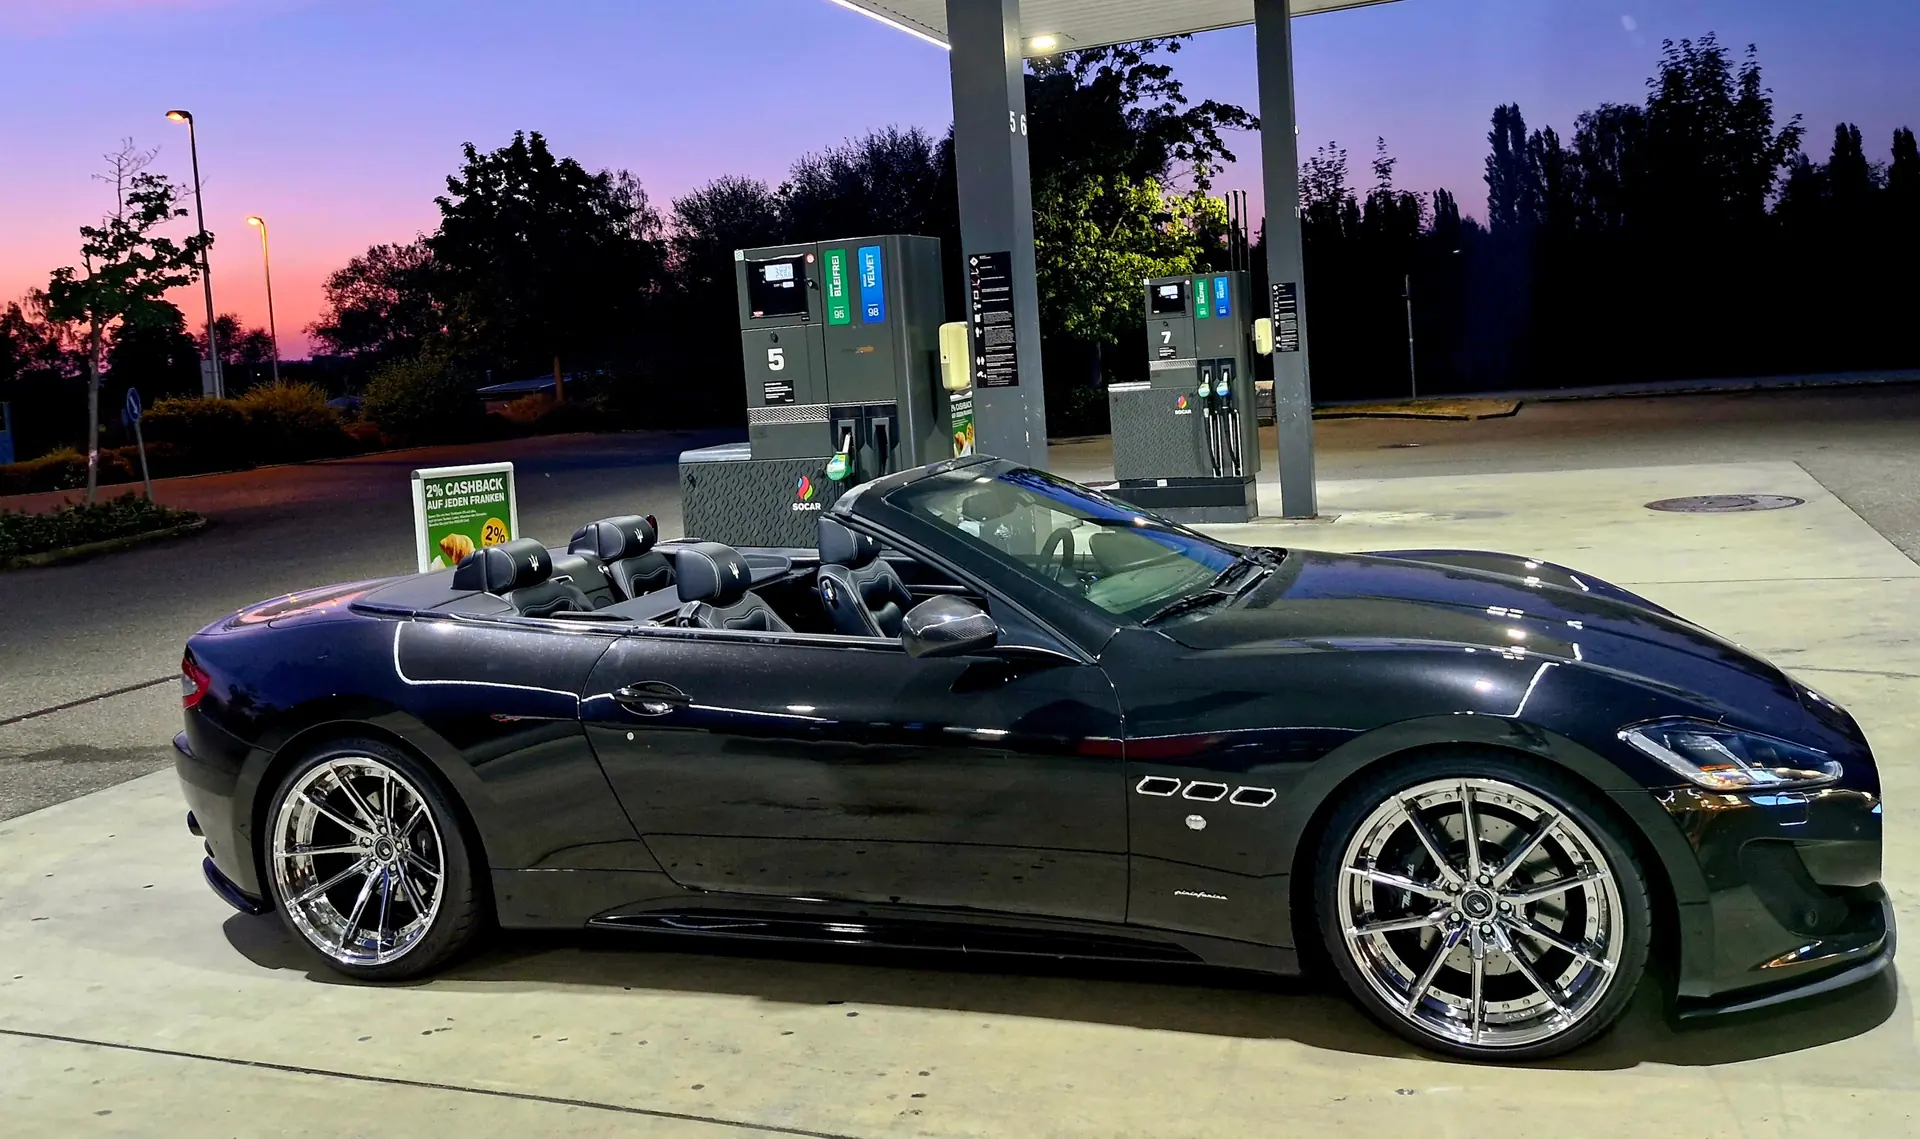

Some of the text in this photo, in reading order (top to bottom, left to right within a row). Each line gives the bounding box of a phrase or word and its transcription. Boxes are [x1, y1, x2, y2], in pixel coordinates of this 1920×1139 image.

[1009, 110, 1028, 136] 5 6
[831, 255, 842, 297] BLEIFREI
[865, 253, 876, 288] VELVET
[833, 309, 845, 319] 95
[867, 307, 880, 317] 98
[1160, 331, 1172, 344] 7
[767, 348, 785, 371] 5
[425, 477, 504, 498] 2% CASHBACK
[427, 492, 505, 510] AUF JEDEN FRANKEN
[792, 502, 821, 511] SOCAR
[485, 525, 506, 544] 2%
